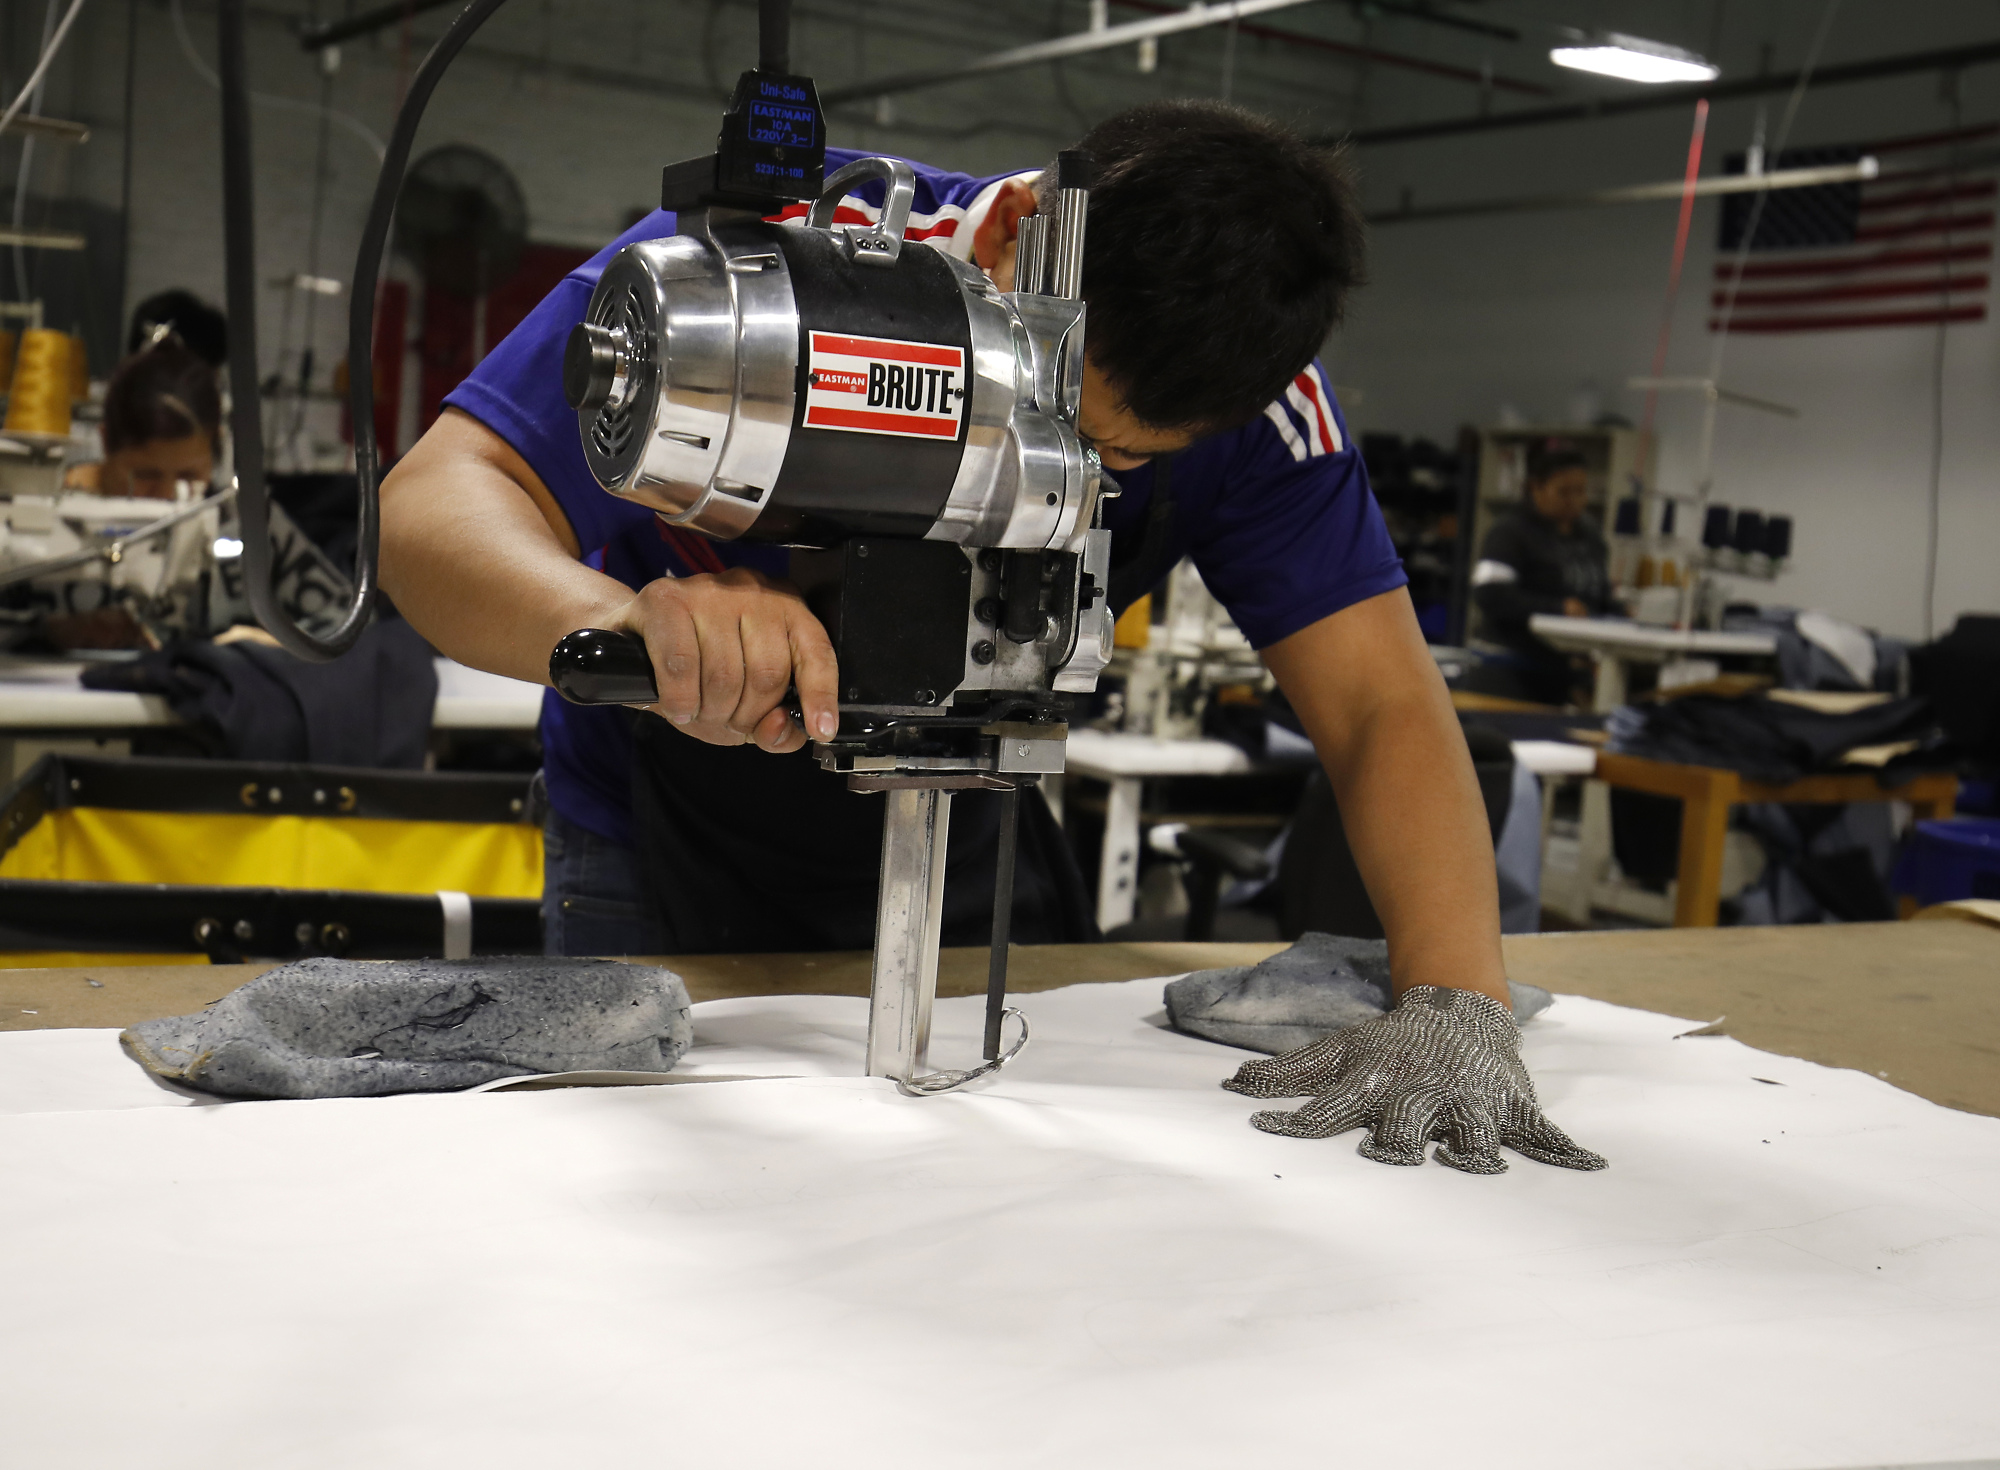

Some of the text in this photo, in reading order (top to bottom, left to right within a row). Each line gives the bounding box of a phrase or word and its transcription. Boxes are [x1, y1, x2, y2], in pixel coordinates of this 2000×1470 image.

[760, 82, 806, 101] Uni-Safe
[754, 105, 812, 122] EASTMAN
[756, 129, 785, 142] 220V
[819, 362, 955, 414] EASTMAN BRUTE
